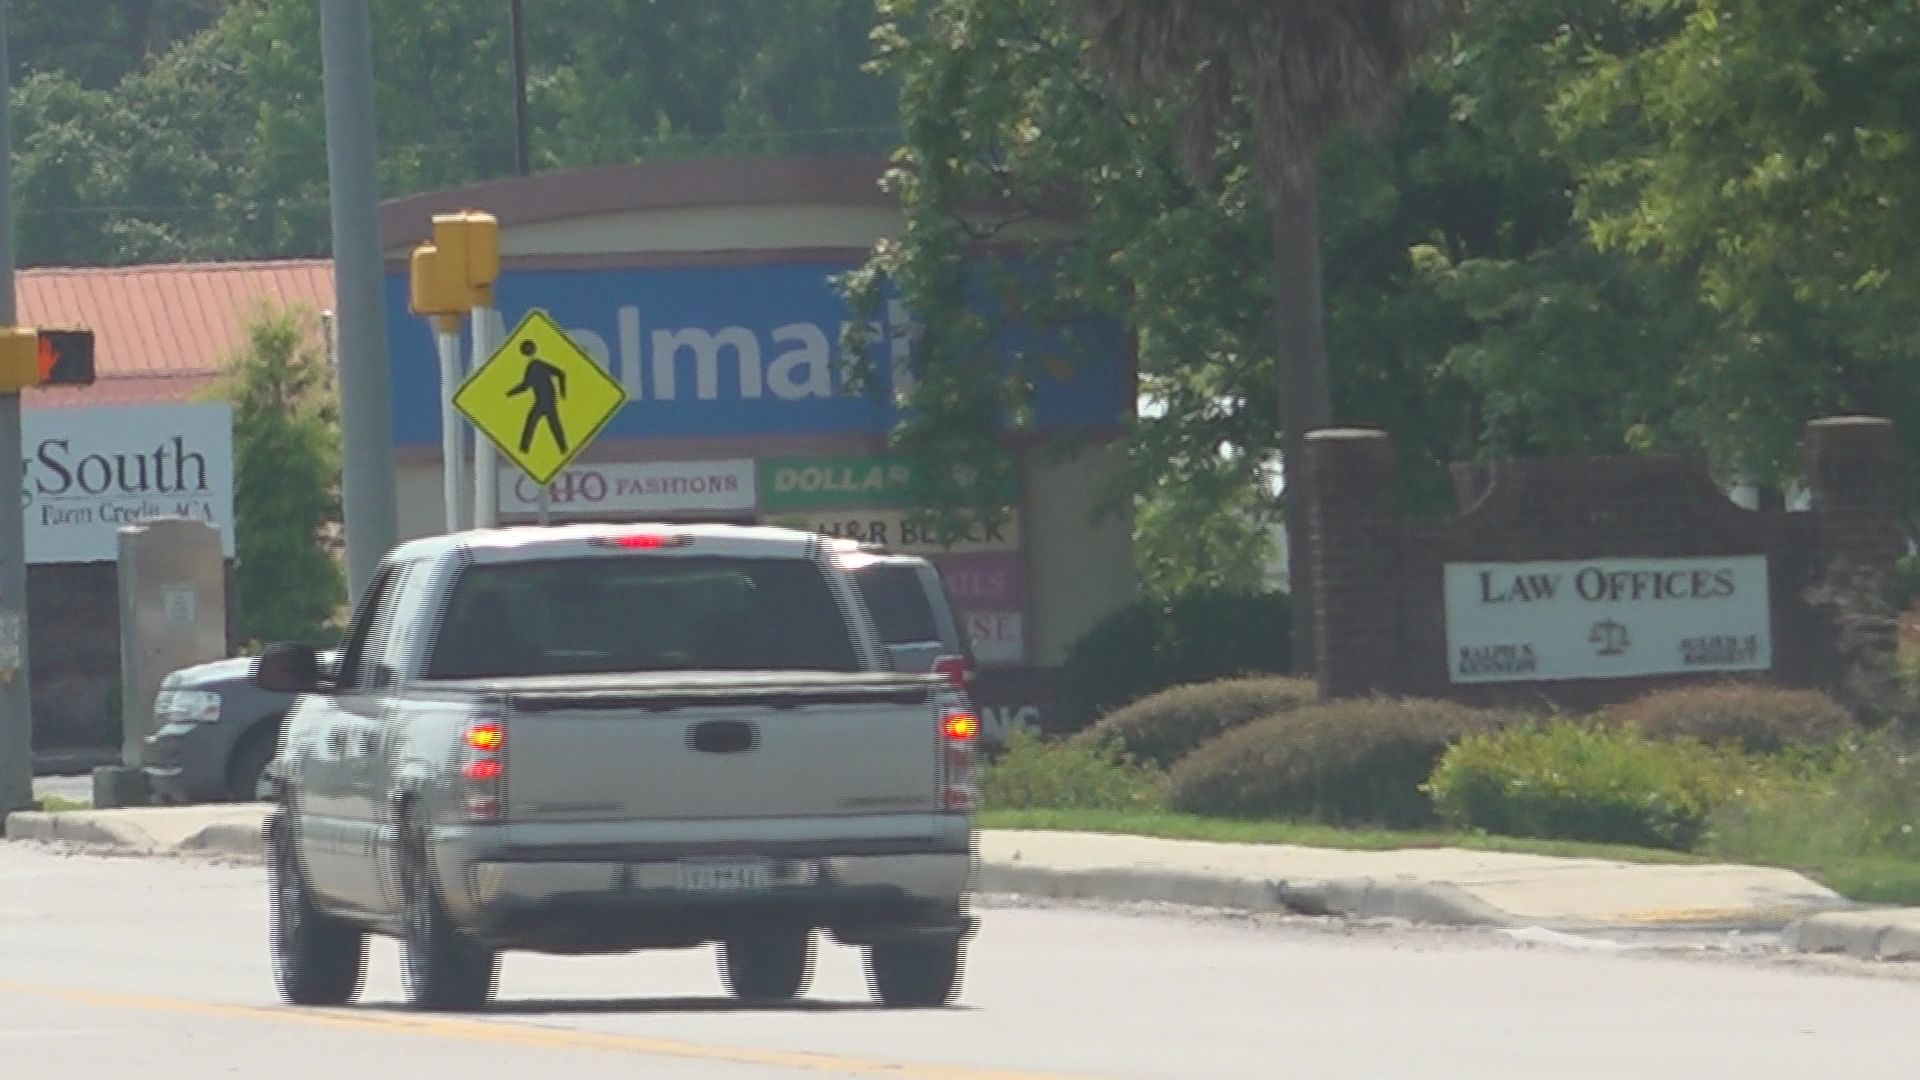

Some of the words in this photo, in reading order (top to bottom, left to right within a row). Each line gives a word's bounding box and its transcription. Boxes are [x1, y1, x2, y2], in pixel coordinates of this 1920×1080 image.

[428, 299, 926, 402] lmart
[23, 433, 209, 510] South
[615, 475, 739, 497] FASHIONS
[40, 504, 92, 525] Farm
[1480, 570, 1560, 603] LAW
[1575, 566, 1735, 601] OFFICES
